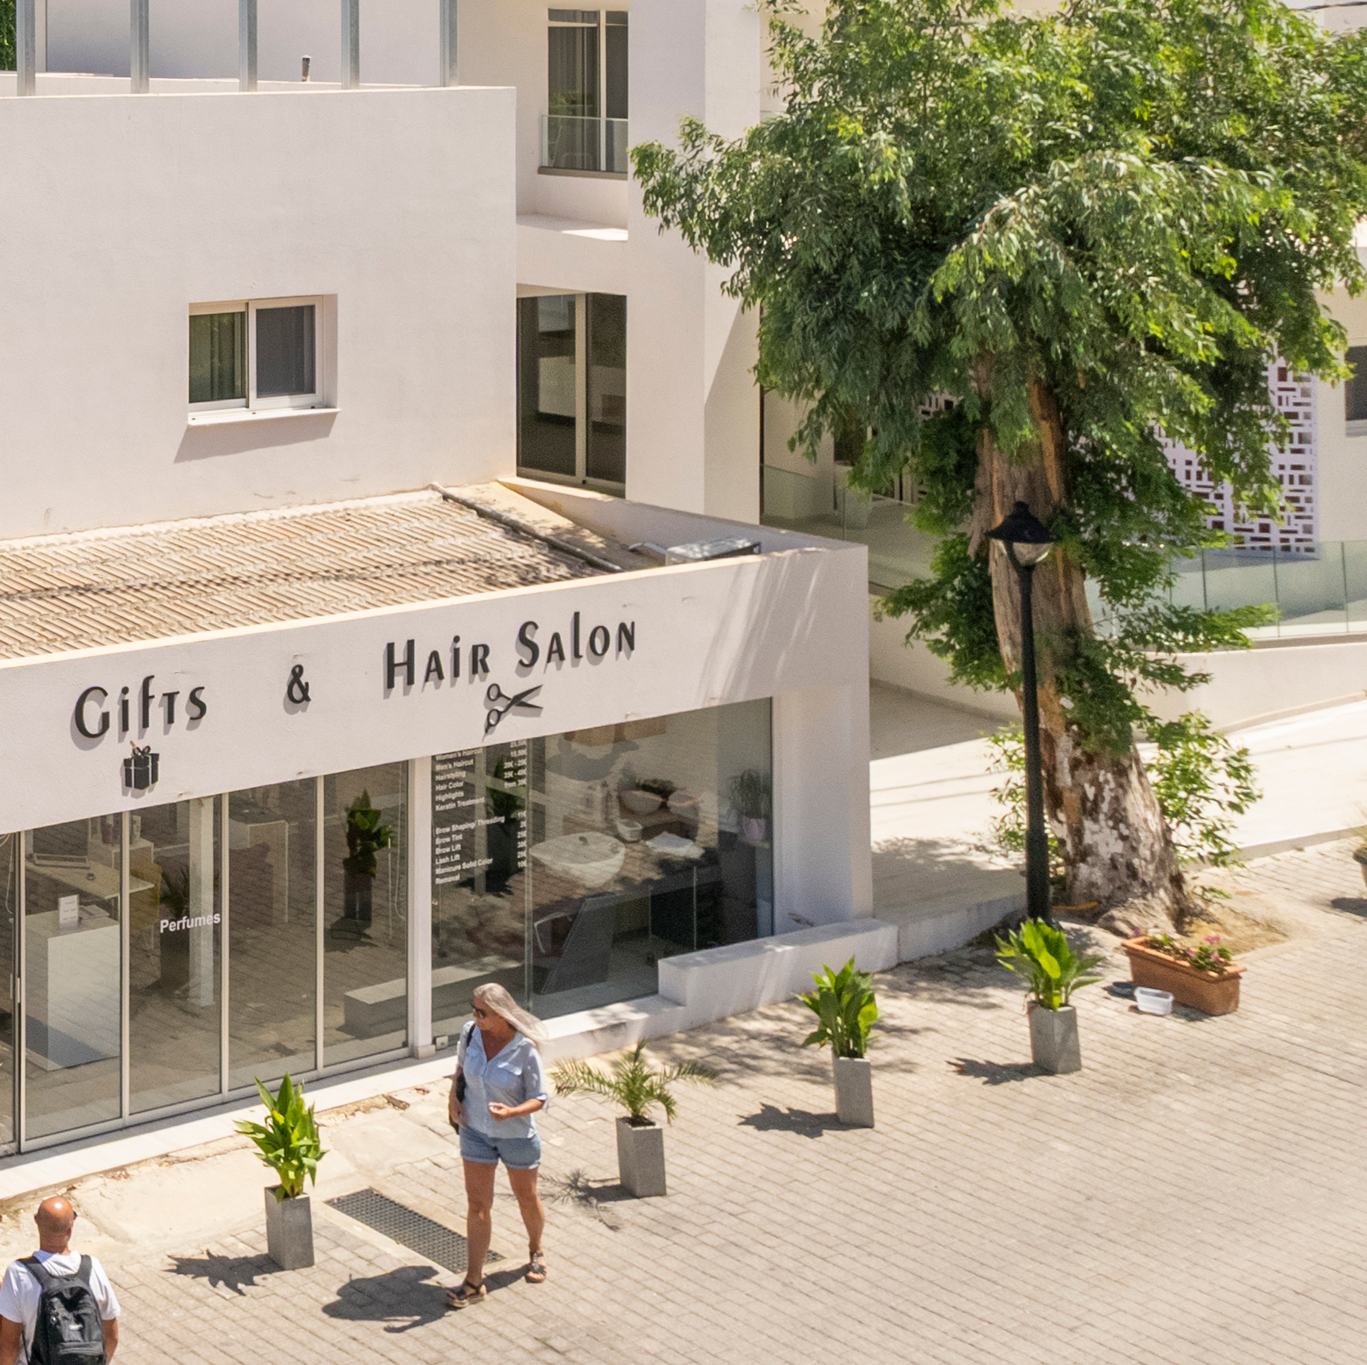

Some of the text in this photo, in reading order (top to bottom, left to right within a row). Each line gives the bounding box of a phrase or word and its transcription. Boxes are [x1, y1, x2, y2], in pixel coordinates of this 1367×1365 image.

[286, 664, 312, 705] &
[453, 759, 474, 768] Haircut
[435, 771, 466, 781] Hairstyling
[435, 781, 464, 791] Hair Color
[435, 791, 464, 802] Highlights
[435, 796, 485, 811] Keratin Treatment
[435, 827, 450, 835] Brow
[477, 815, 505, 826] Threading
[435, 837, 450, 845] Brow
[451, 843, 462, 852] Lift
[435, 853, 460, 865] Lash Lift
[435, 858, 493, 874] Manicure Solid Color
[435, 874, 461, 885] Removal
[159, 913, 221, 934] Perfumes
